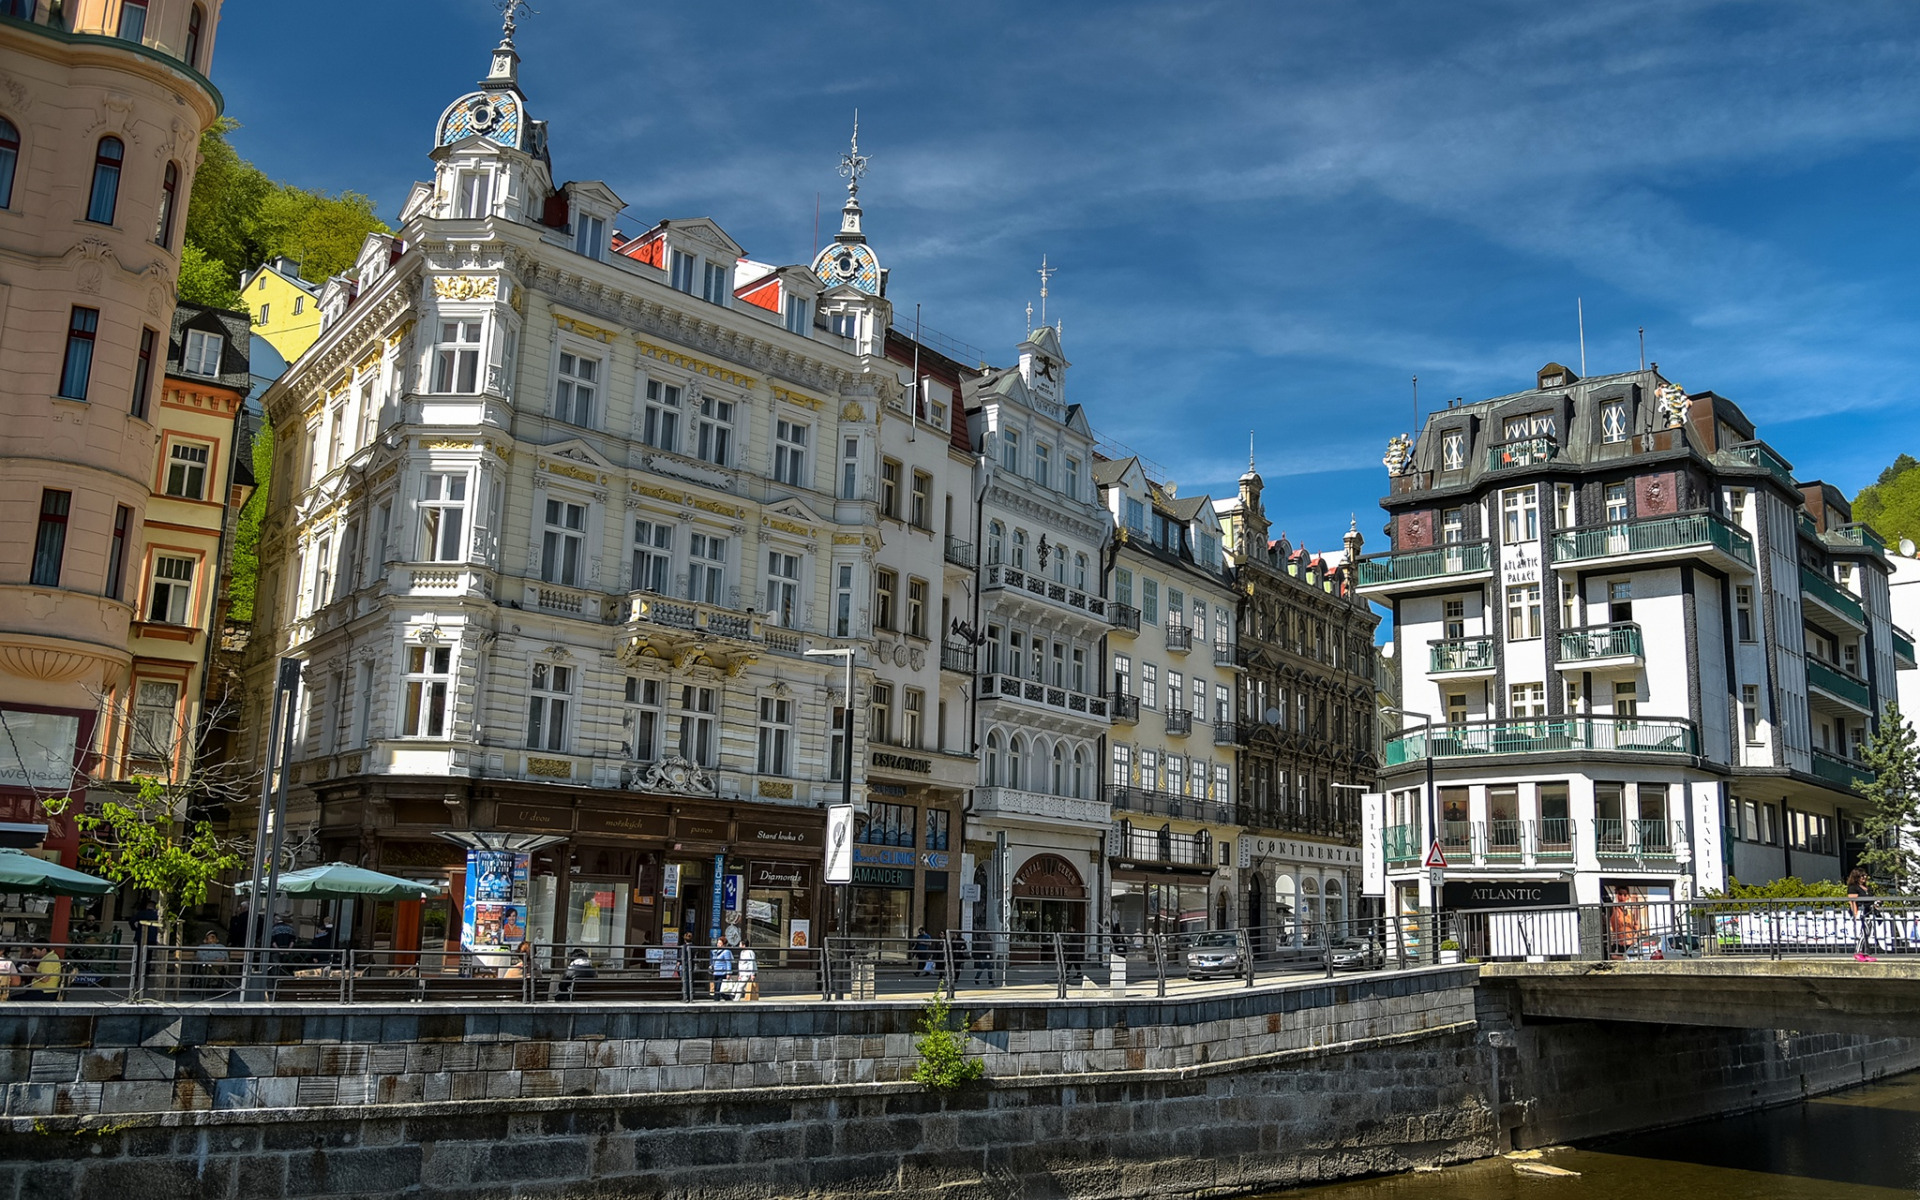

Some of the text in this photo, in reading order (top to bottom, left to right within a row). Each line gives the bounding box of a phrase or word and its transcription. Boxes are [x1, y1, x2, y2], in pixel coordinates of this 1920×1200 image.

[1504, 557, 1538, 571] ATLANTIC
[1507, 570, 1535, 582] PALACE
[872, 752, 932, 774] ESPLANADE
[519, 811, 551, 822] U dvou
[690, 826, 713, 834] panen
[778, 831, 796, 841] louka
[1257, 839, 1361, 863] CONTINENTAL
[880, 850, 916, 866] CLINIC
[759, 869, 802, 882] Diamonds
[1021, 861, 1076, 885] ROYAL CZECH
[1029, 885, 1068, 897] SOUVENIR
[1470, 888, 1542, 901] ATLANTIC
